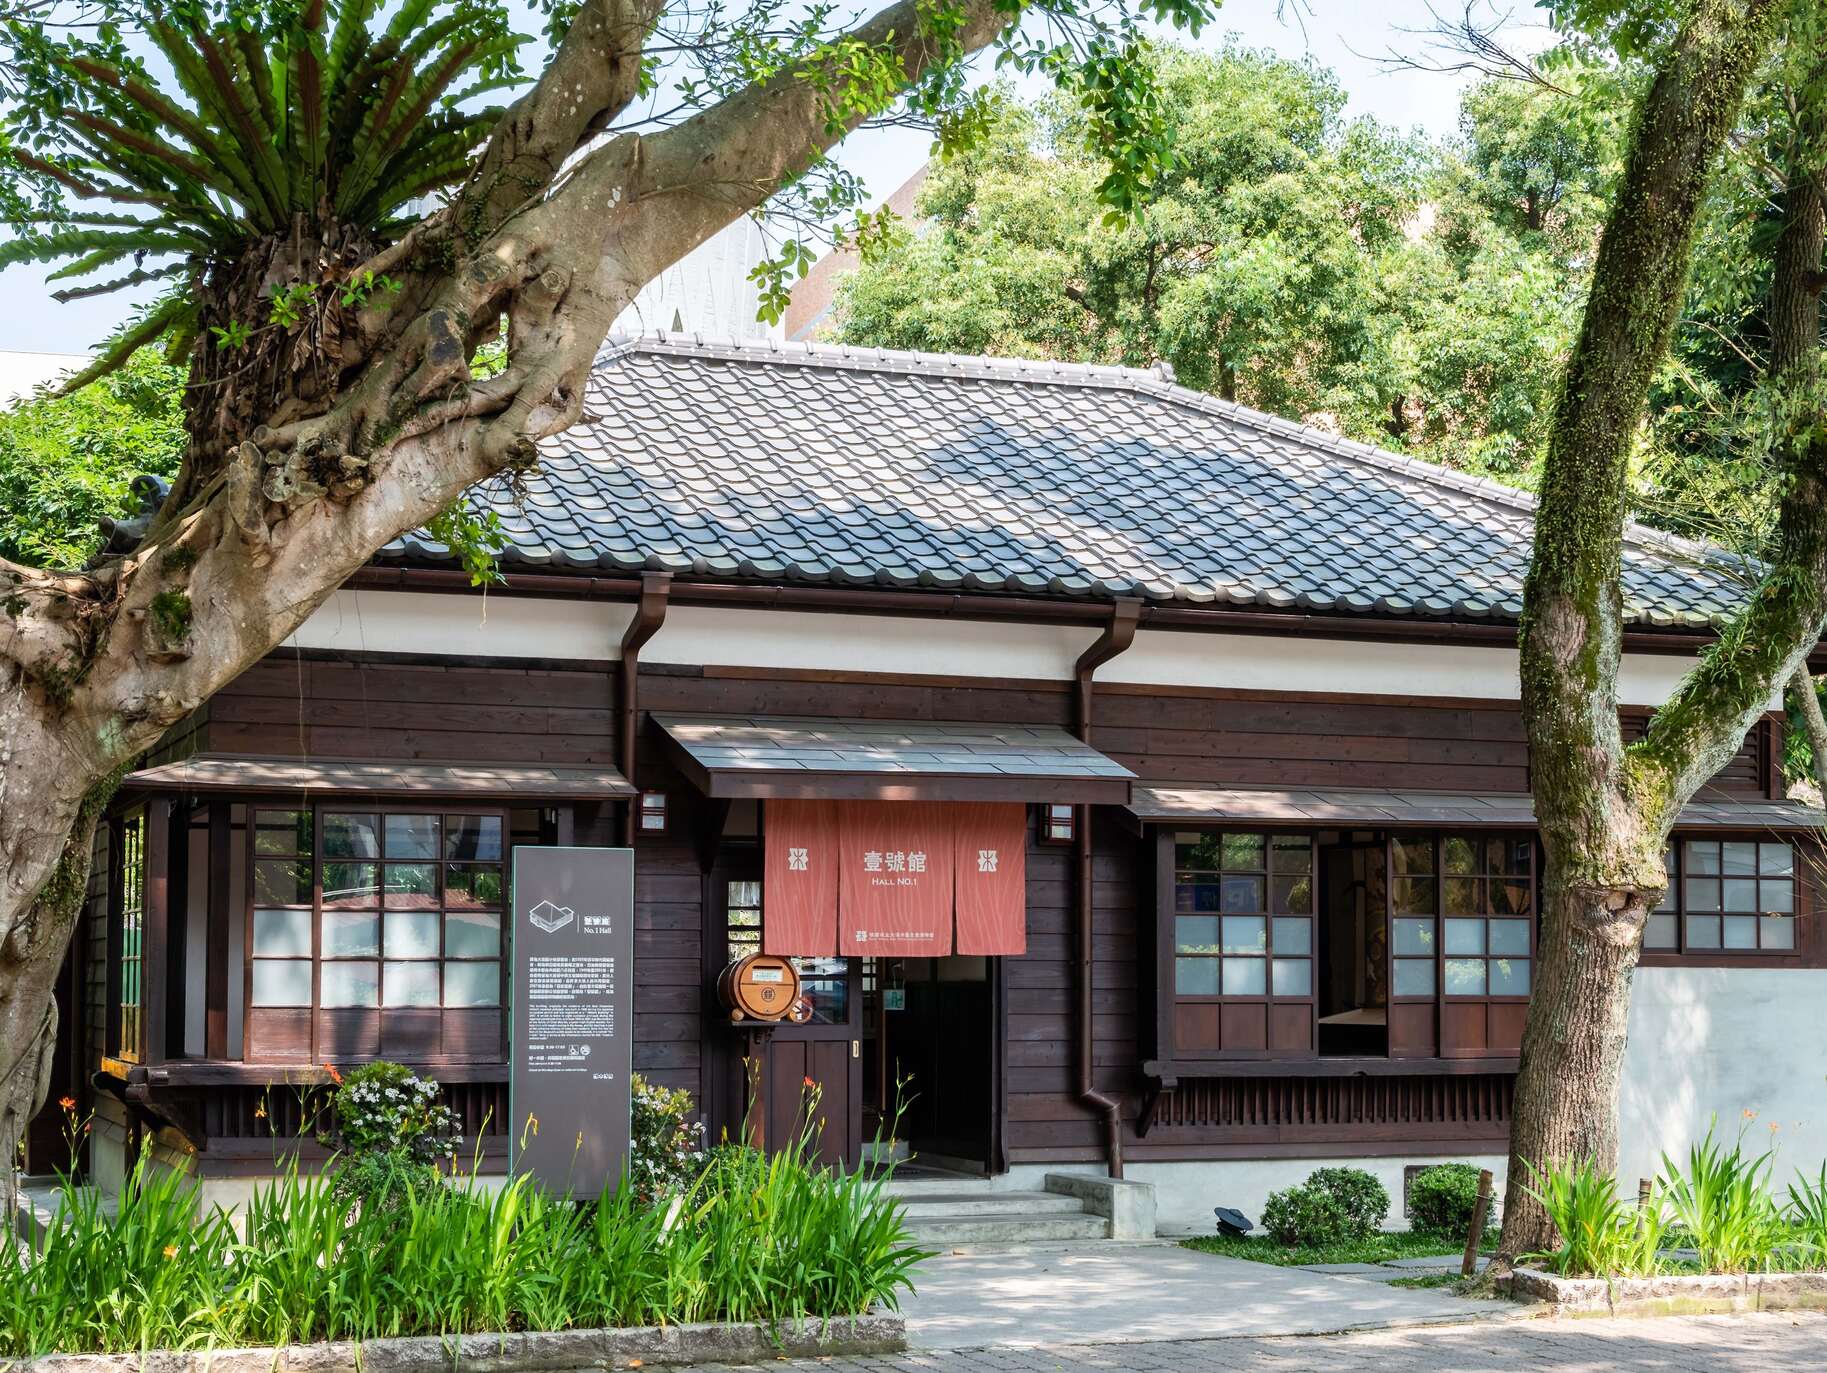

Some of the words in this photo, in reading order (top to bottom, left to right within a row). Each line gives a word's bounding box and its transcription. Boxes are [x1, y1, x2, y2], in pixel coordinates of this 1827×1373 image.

[864, 851, 926, 872] 壹號館
[872, 878, 895, 886] HALL
[897, 878, 917, 886] NO.1
